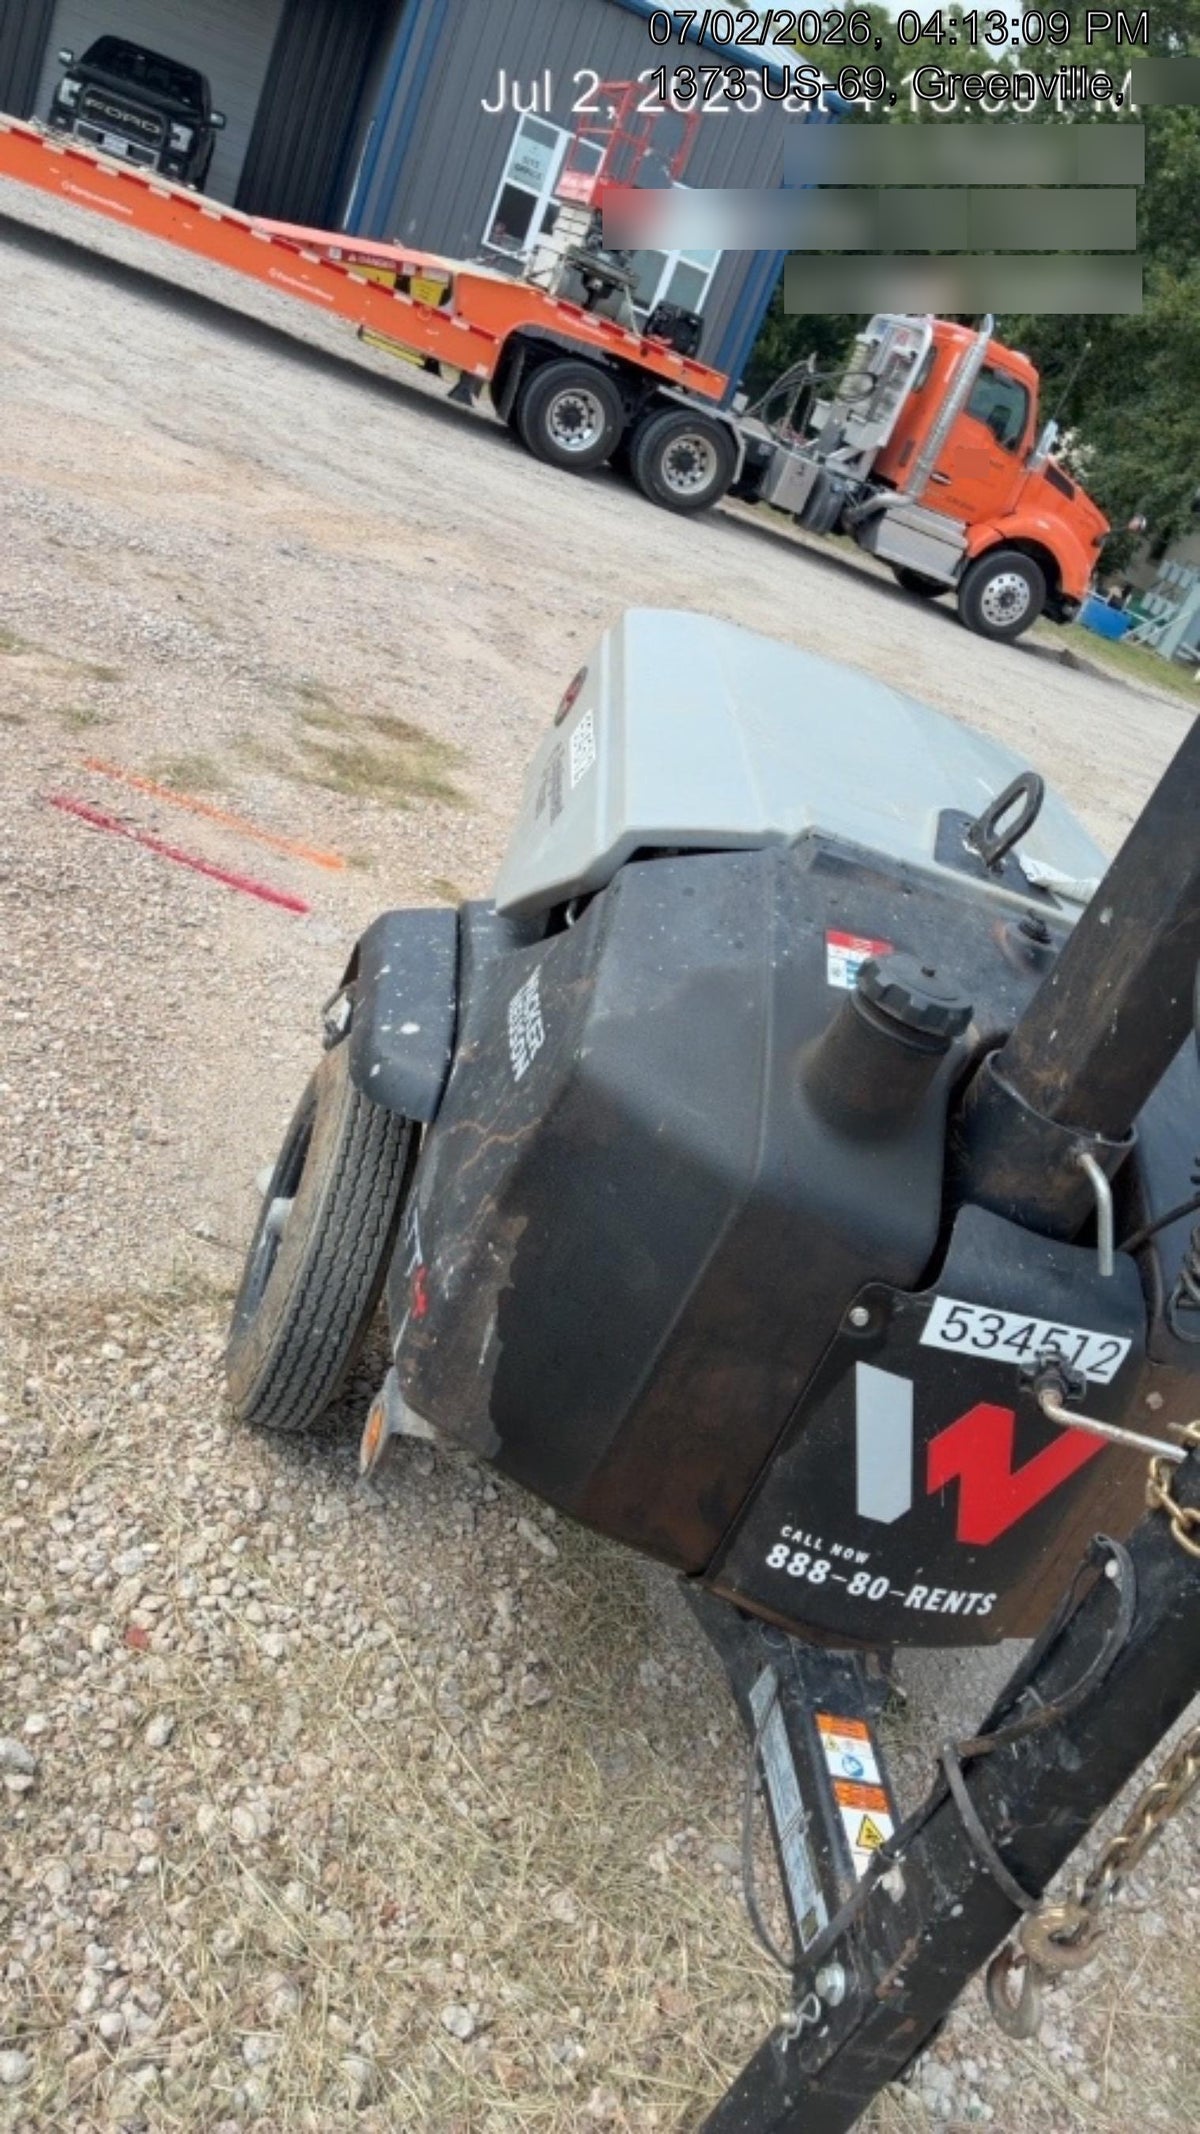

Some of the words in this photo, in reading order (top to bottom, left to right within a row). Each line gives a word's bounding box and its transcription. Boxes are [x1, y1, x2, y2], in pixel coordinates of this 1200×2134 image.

[940, 1305, 1122, 1376] 534512
[765, 1543, 997, 1616] 888-80-RENTS
[780, 1525, 823, 1550] CALL
[830, 1542, 871, 1565] NOW
